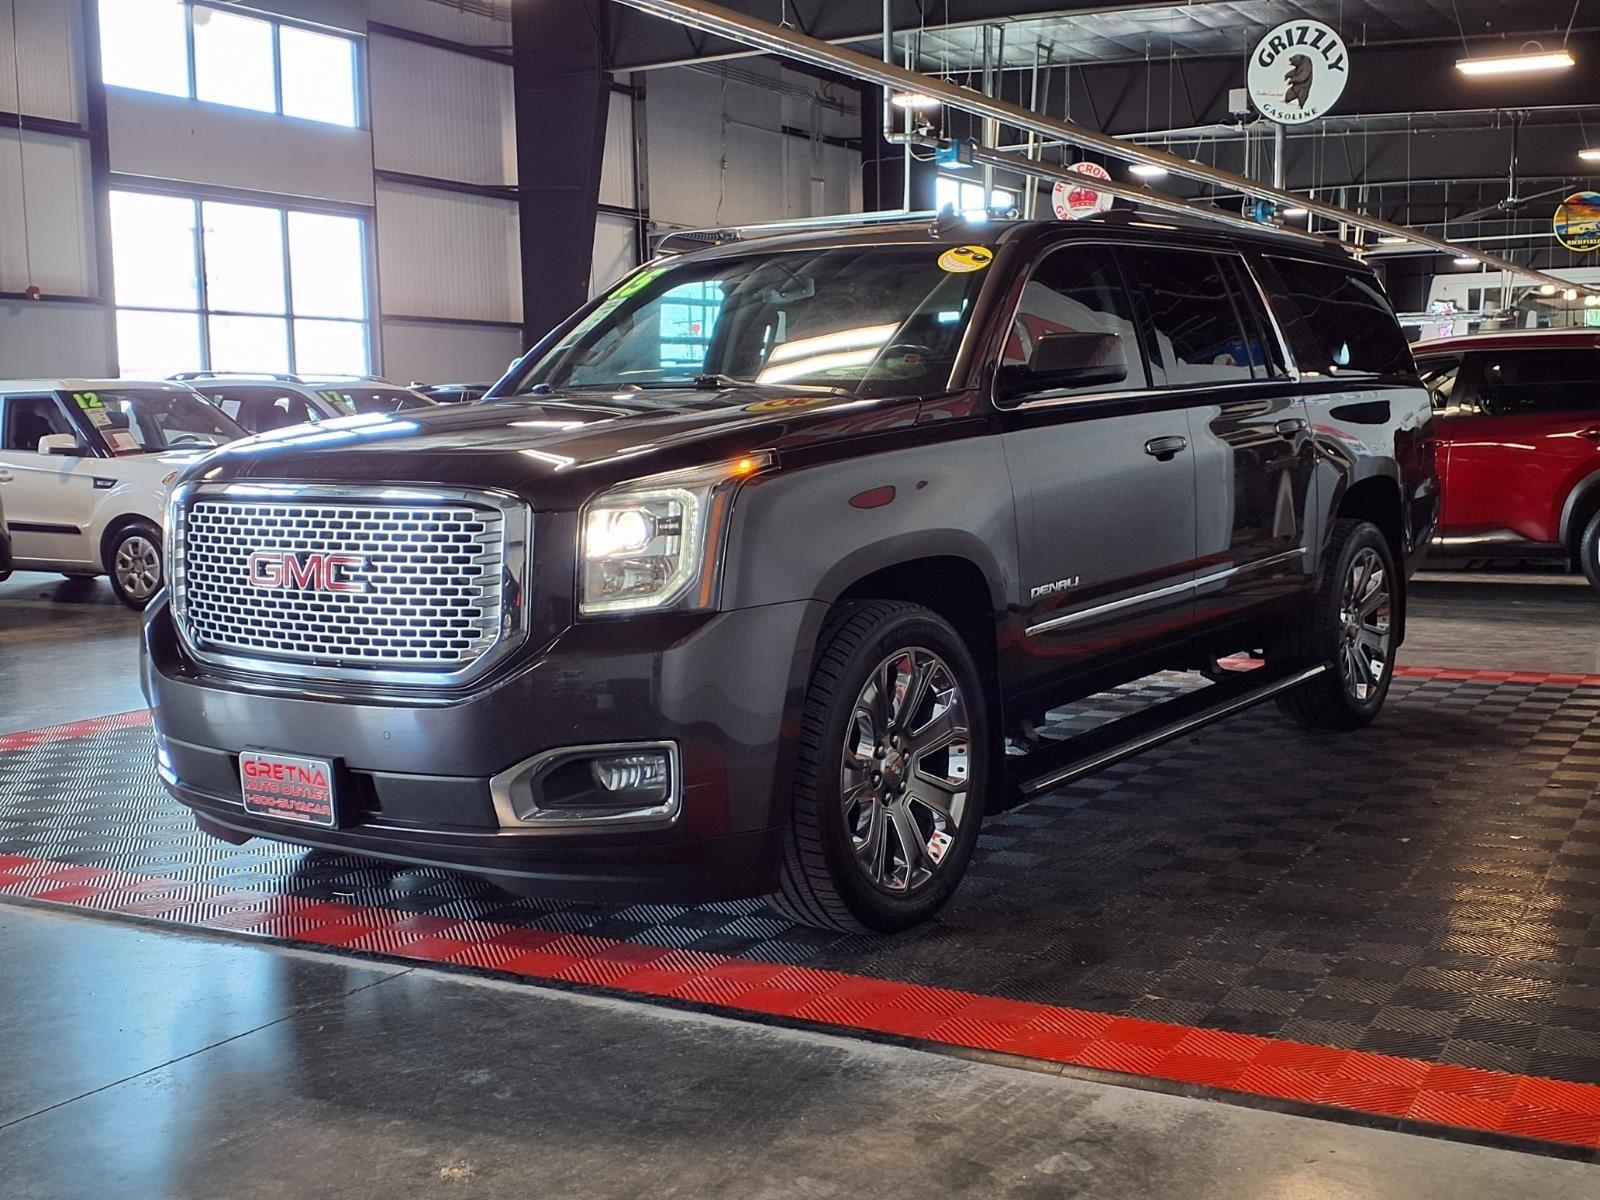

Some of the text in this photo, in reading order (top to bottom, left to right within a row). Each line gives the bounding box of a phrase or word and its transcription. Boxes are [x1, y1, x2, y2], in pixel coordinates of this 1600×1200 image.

[1258, 26, 1344, 72] GRIZZLY
[1263, 104, 1319, 120] GASOLINE
[73, 392, 103, 409] 12
[250, 551, 368, 593] GMC
[1030, 576, 1079, 599] DENALI
[244, 760, 328, 787] GRETNA
[245, 780, 329, 801] AUTO OUTLET
